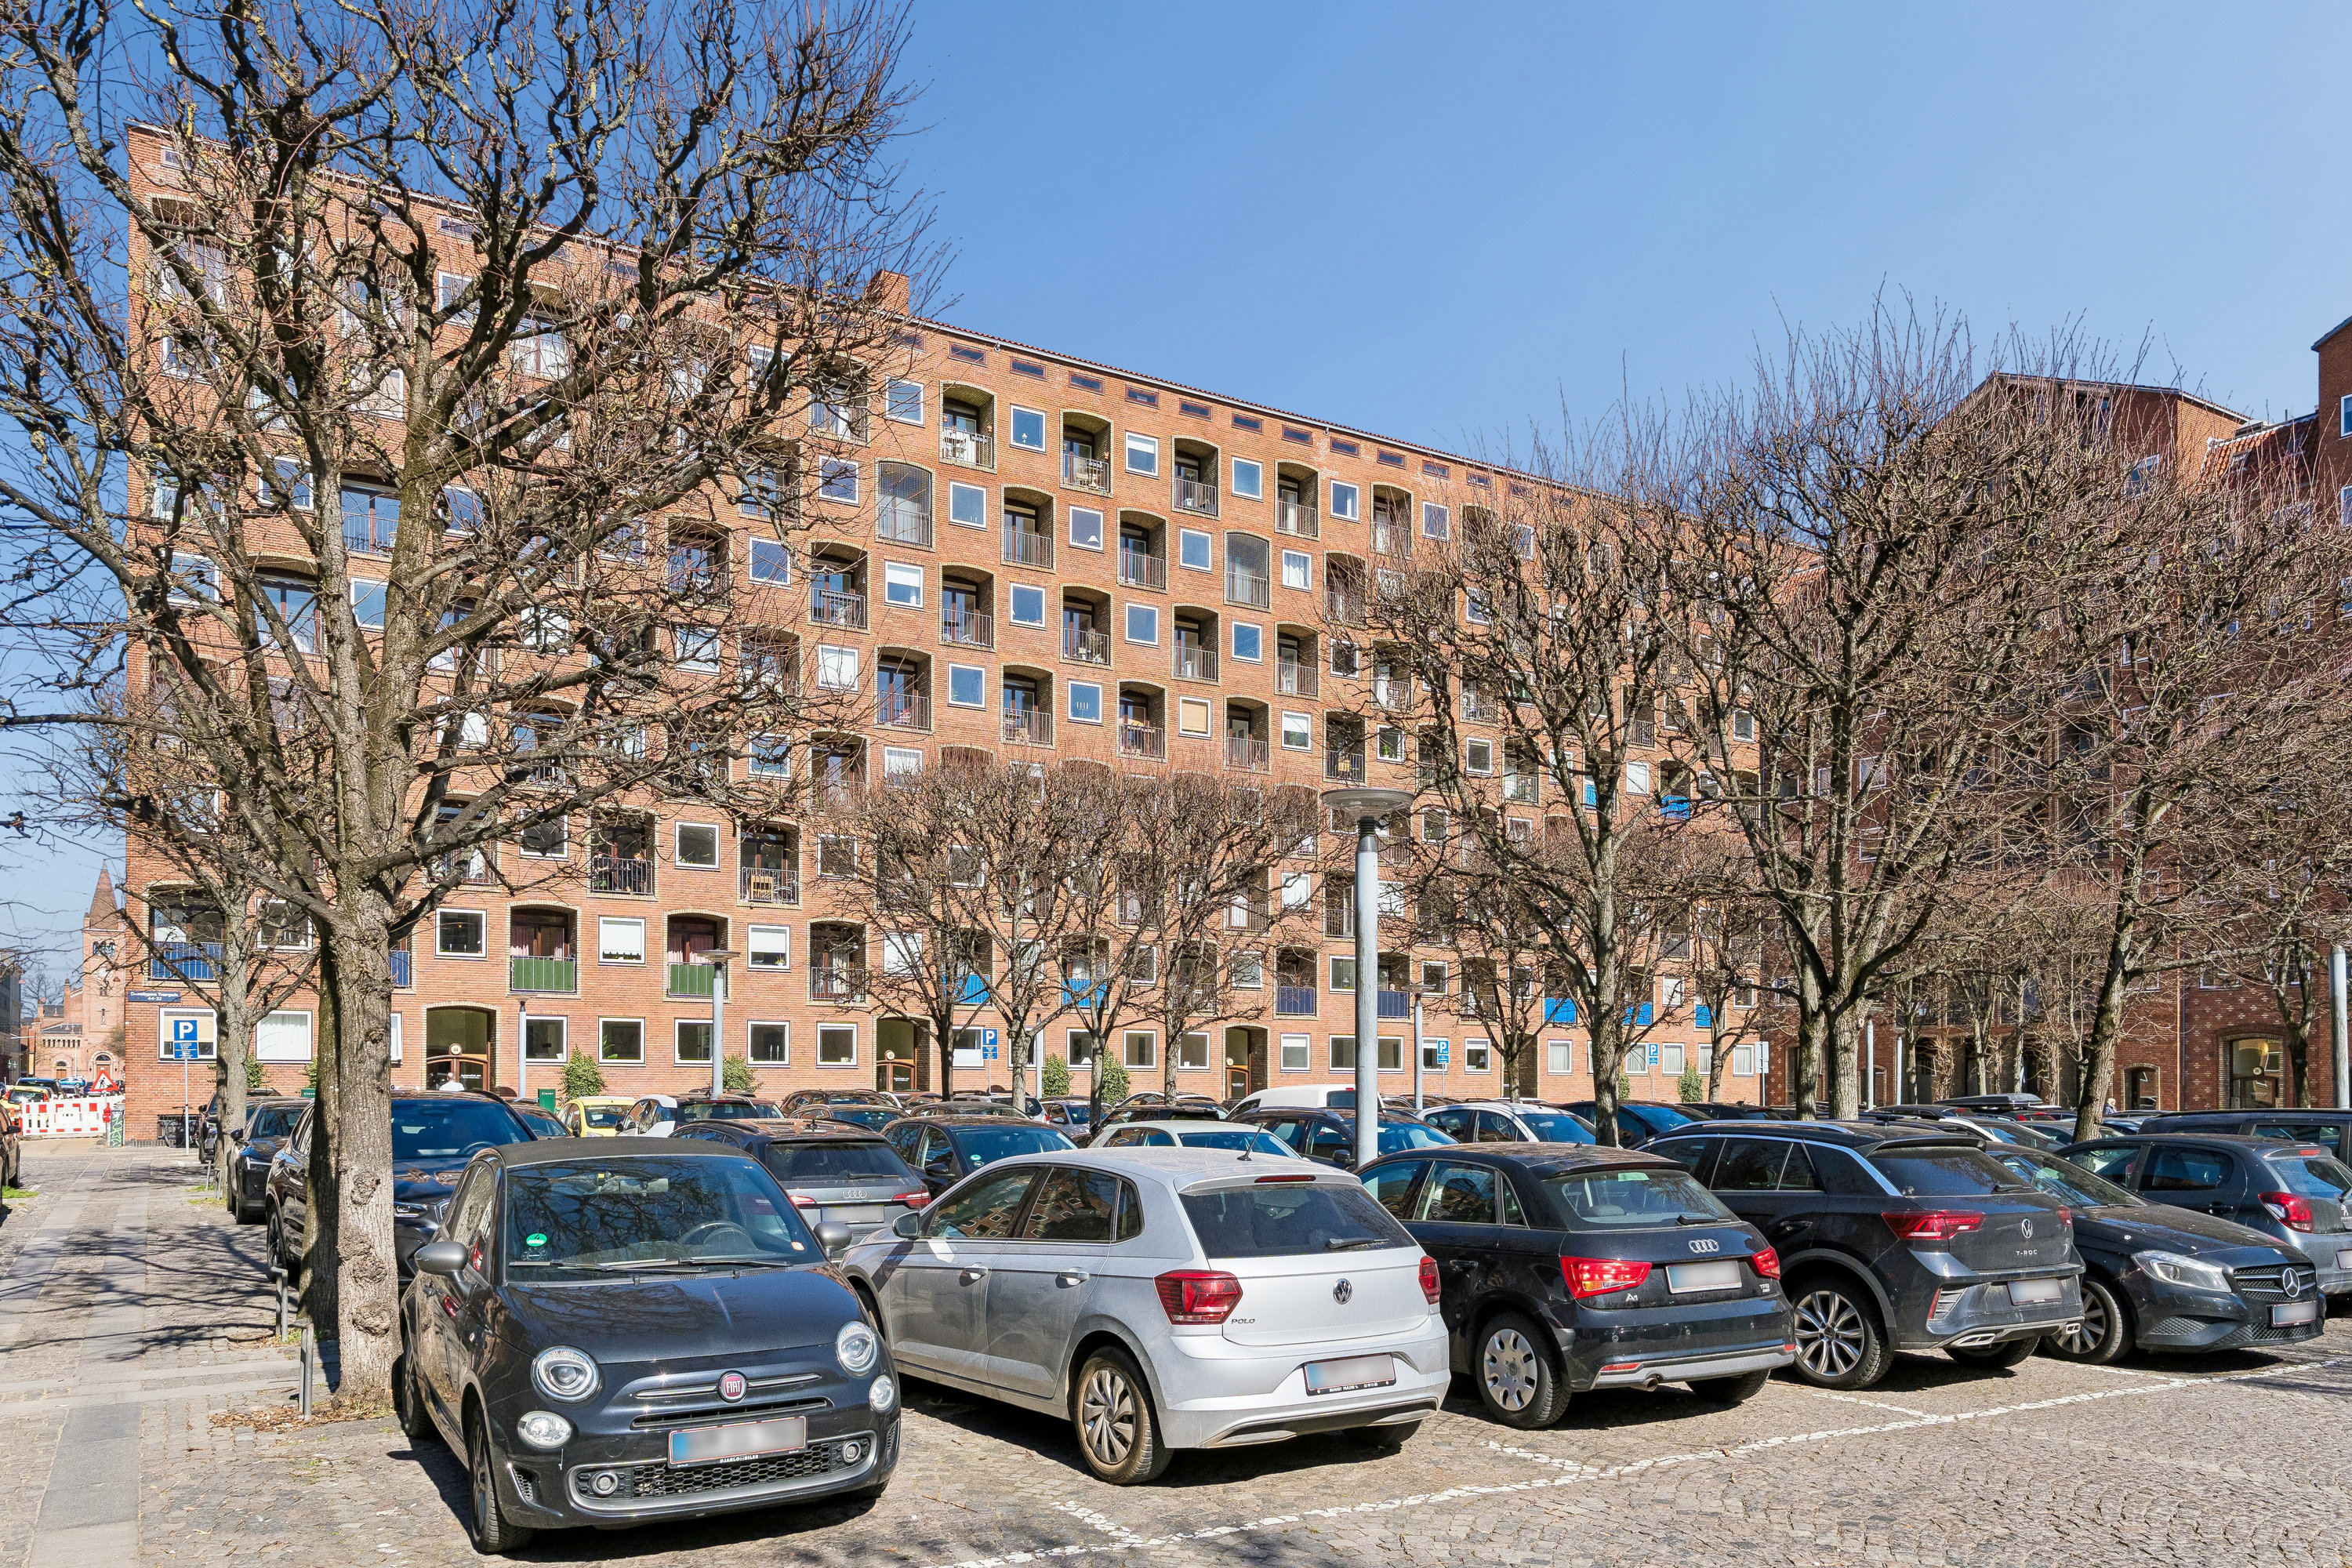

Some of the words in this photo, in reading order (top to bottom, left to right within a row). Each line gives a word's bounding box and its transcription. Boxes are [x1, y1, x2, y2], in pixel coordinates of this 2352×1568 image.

[179, 1022, 194, 1040] P
[985, 1030, 995, 1044] P
[1439, 1041, 1447, 1054] P
[1650, 1044, 1657, 1056] P
[1625, 1293, 1639, 1301] A1
[726, 1380, 742, 1394] FIAT
